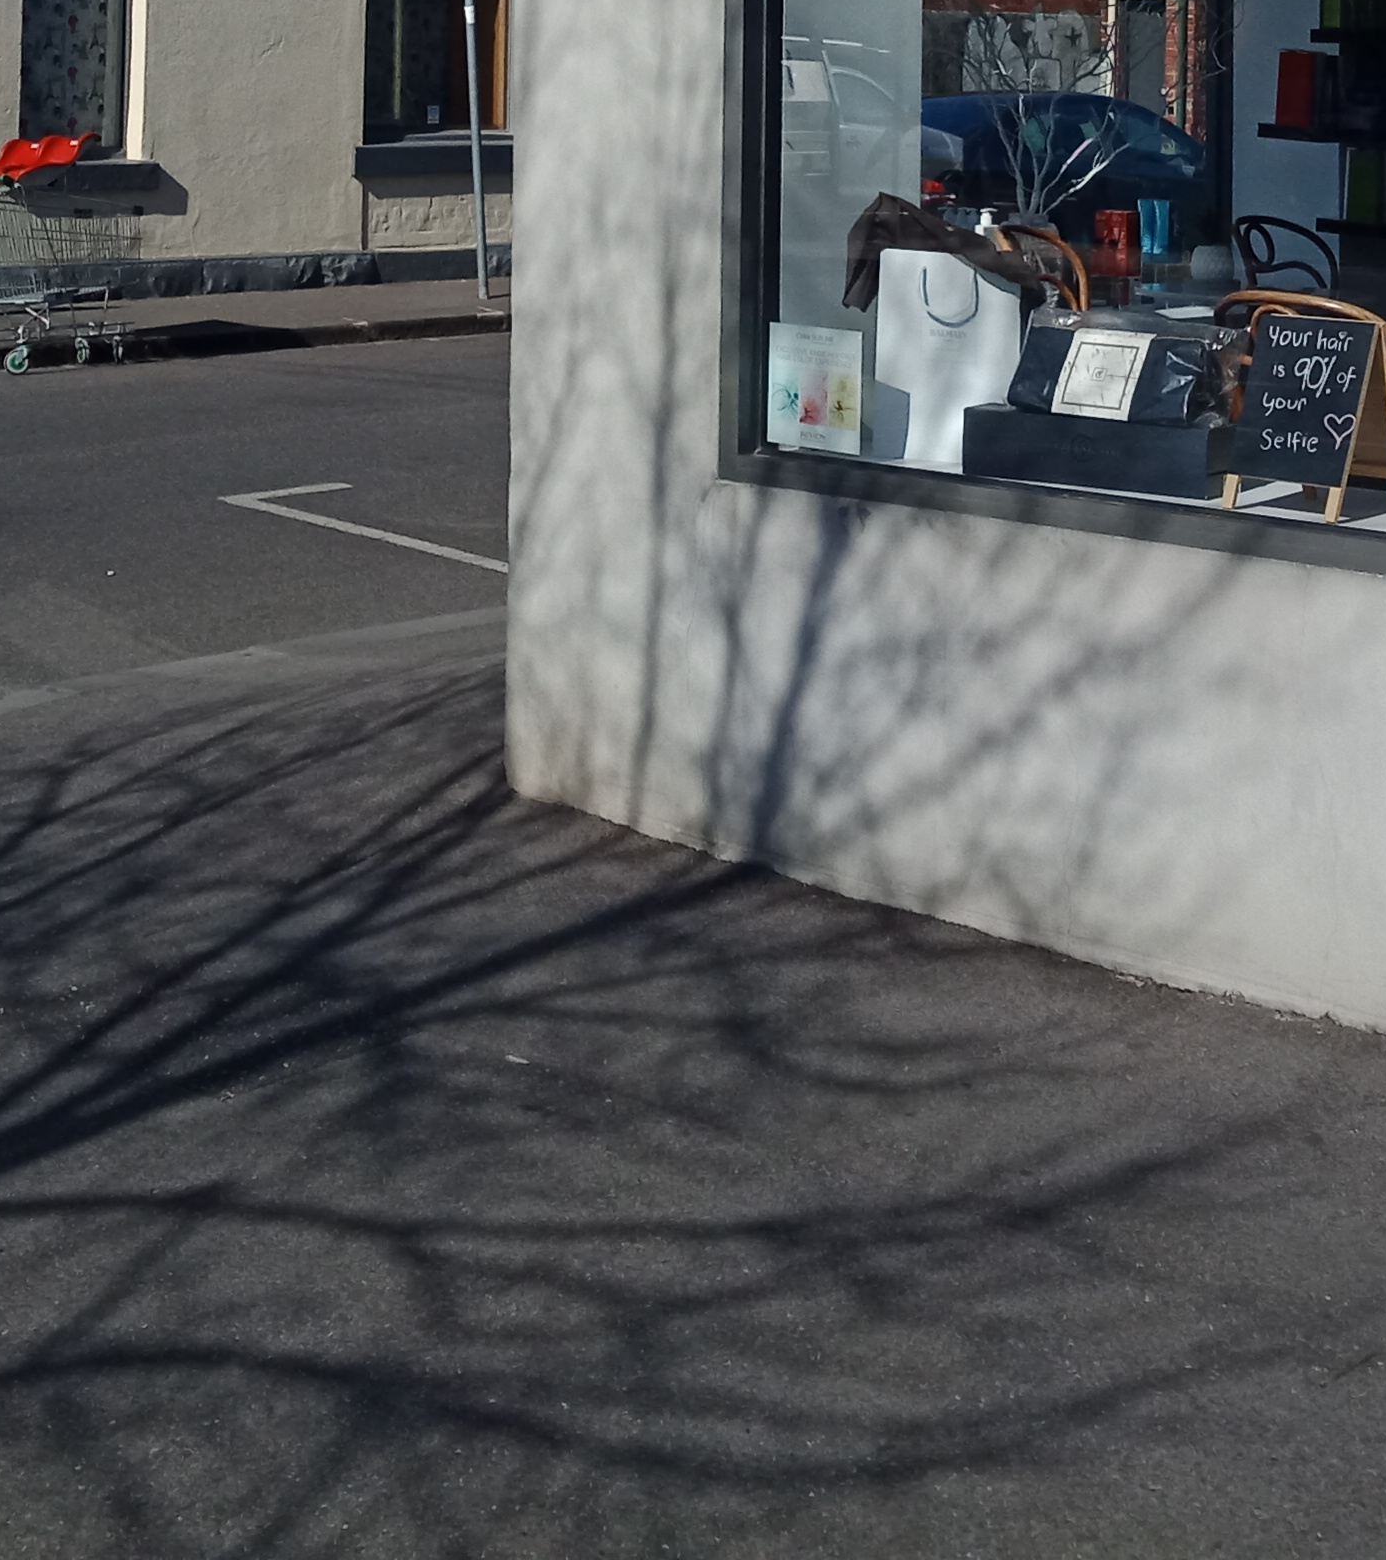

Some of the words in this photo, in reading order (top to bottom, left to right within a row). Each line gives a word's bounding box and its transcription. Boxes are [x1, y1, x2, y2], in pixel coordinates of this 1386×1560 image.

[929, 328, 967, 339] BALMAIN
[1316, 328, 1354, 352] hair
[1272, 363, 1285, 378] is
[1293, 355, 1338, 398] 90%
[1336, 365, 1357, 393] of
[1262, 391, 1307, 416] your
[1259, 428, 1319, 453] Selfie
